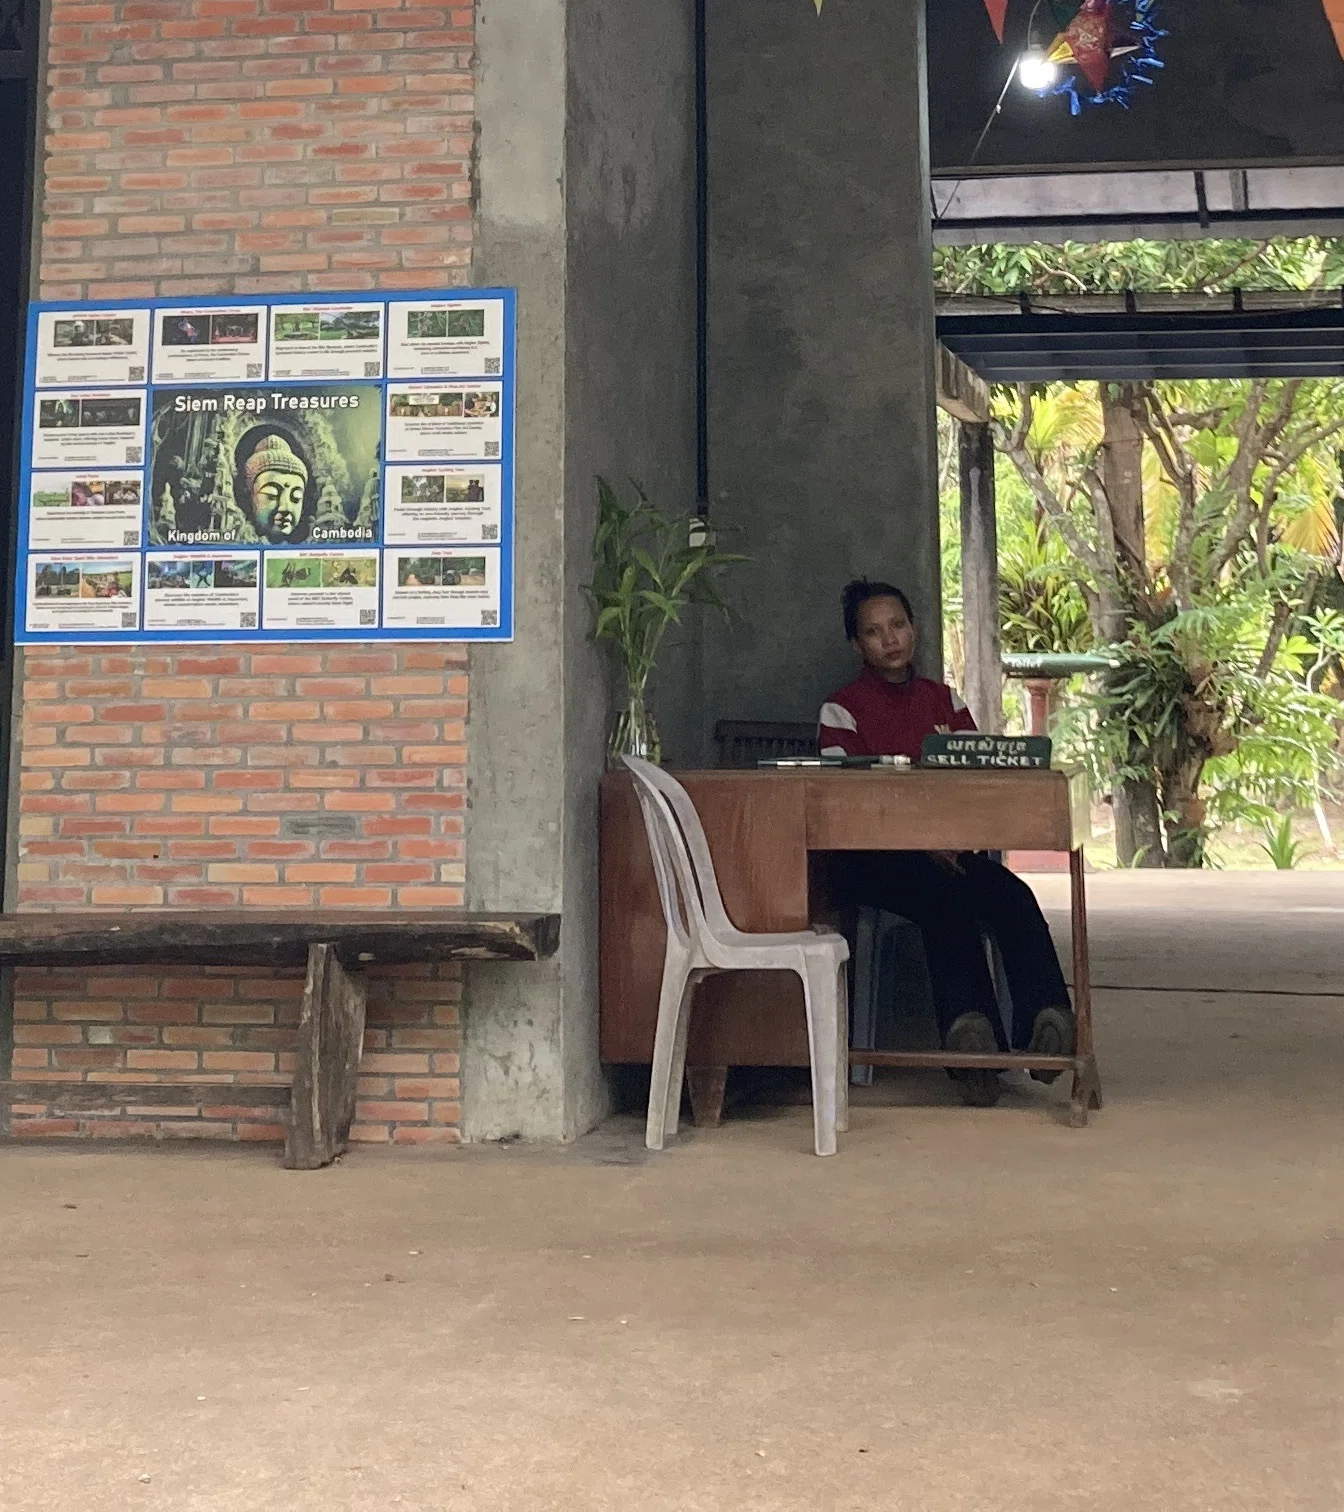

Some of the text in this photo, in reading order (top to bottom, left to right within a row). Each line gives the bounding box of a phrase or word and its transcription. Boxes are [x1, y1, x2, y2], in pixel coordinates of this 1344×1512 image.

[175, 393, 360, 414] Siem Reap Treasures
[167, 529, 236, 544] Kingdom of
[312, 526, 373, 539] Cambodia
[976, 754, 1043, 766] TICKET
